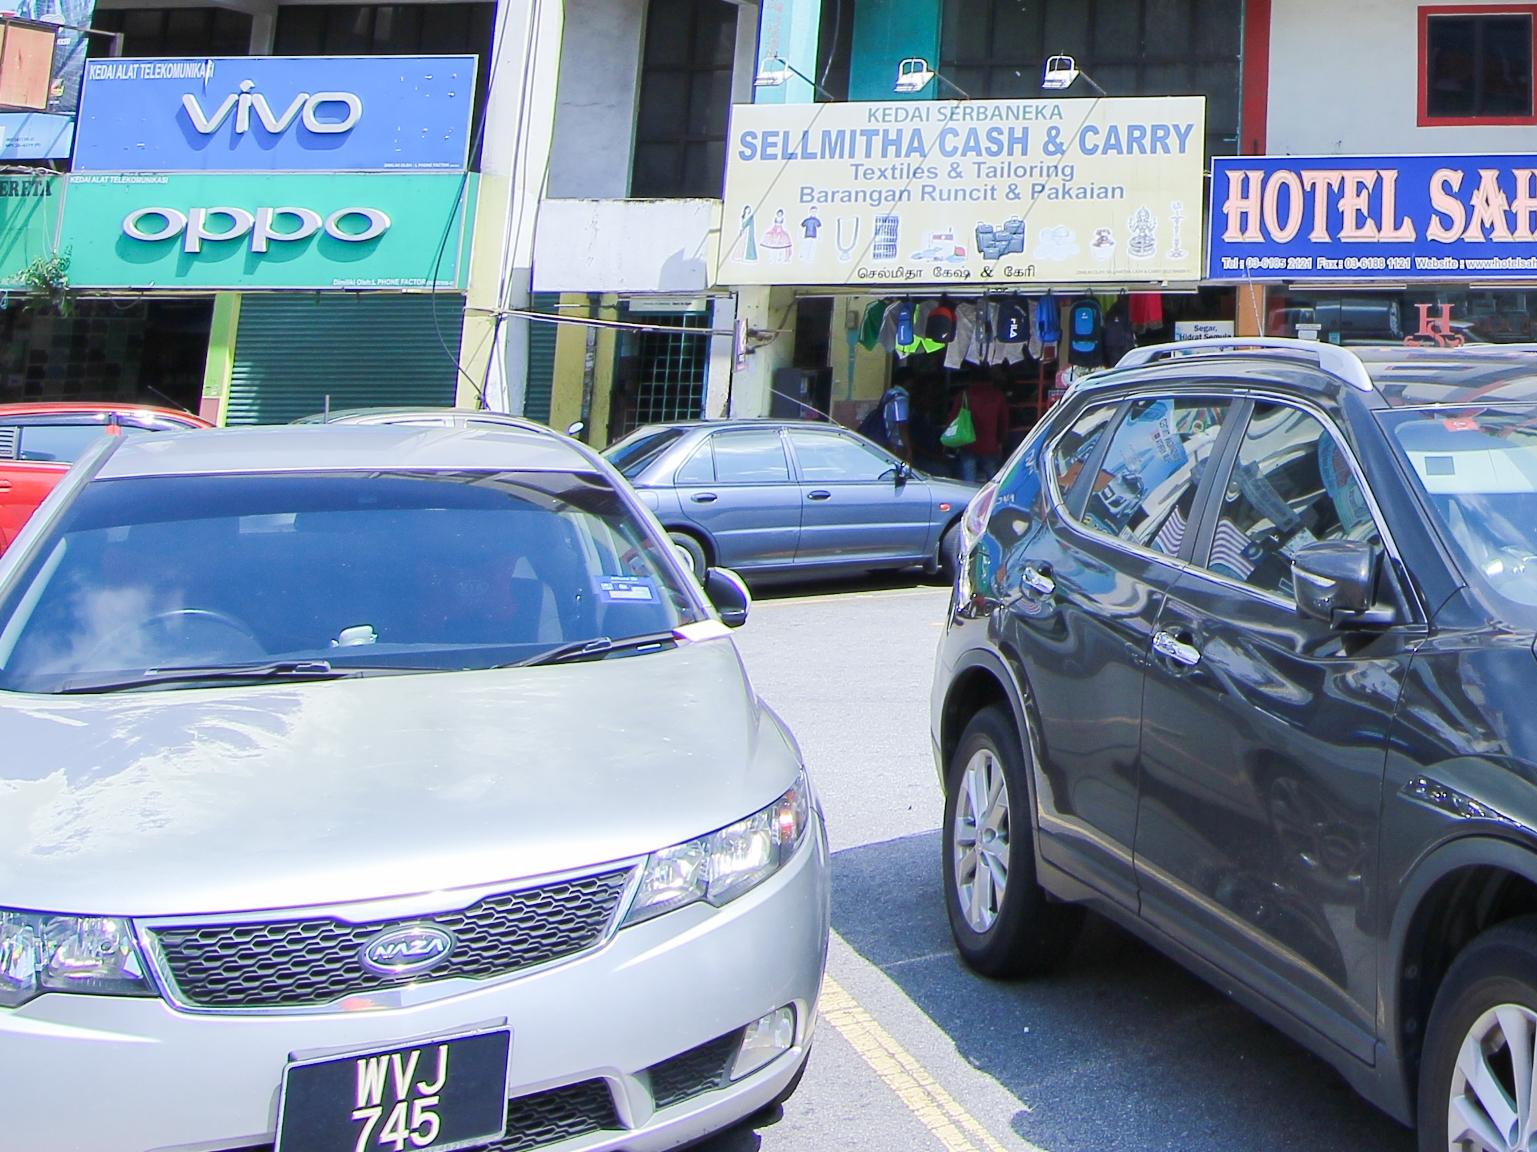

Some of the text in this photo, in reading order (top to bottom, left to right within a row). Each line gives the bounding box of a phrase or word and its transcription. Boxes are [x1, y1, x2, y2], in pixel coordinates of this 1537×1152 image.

[89, 64, 117, 79] KEDAI
[116, 64, 139, 79] ALAT
[182, 79, 363, 134] vivo
[868, 104, 1063, 123] KEDAI SERBANEKA
[738, 123, 1195, 161] SELLMITHA CASH & CARRY
[851, 161, 1075, 182] Textiles & Tailoring
[800, 182, 1125, 207] Barangan Runcit & Pakaian
[1223, 168, 1417, 244] HOTEL
[123, 207, 391, 253] oppo
[981, 266, 994, 278] &
[1222, 257, 1239, 269] Tel
[1317, 258, 1337, 269] Fax
[1415, 257, 1457, 269] Website
[373, 939, 444, 960] NAZA
[356, 1045, 448, 1109] WVJ
[352, 1096, 440, 1152] 745
